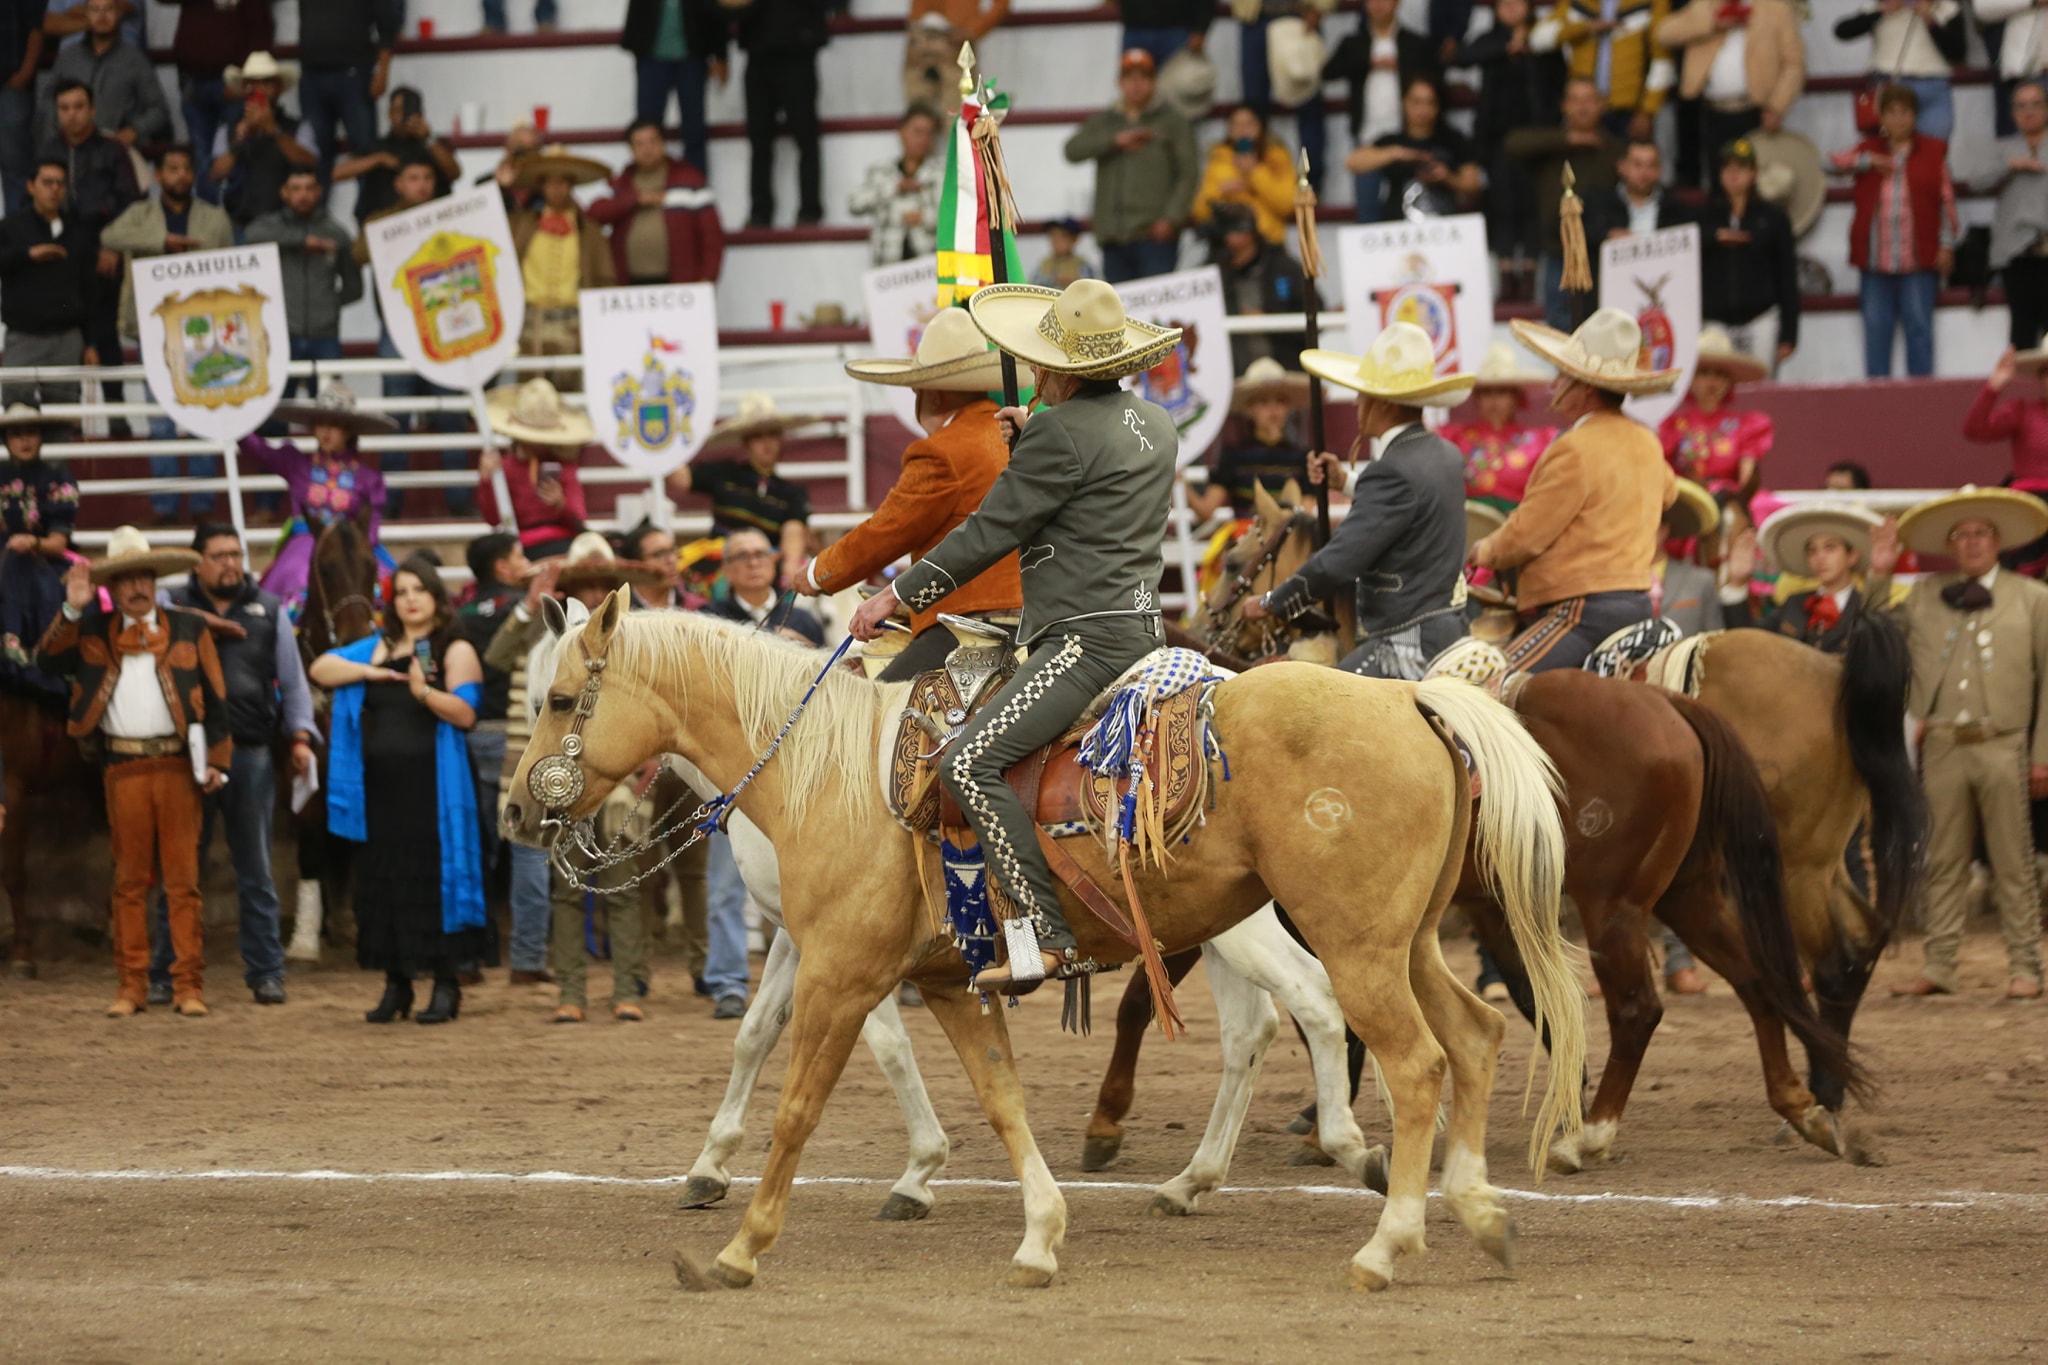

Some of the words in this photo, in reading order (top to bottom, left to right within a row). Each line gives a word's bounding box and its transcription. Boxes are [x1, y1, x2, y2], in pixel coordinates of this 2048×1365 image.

[1361, 223, 1461, 253] OAXACA
[1608, 227, 1691, 266] SINALOA
[152, 253, 261, 280] COAHUILA
[600, 290, 694, 316] JALISCO
